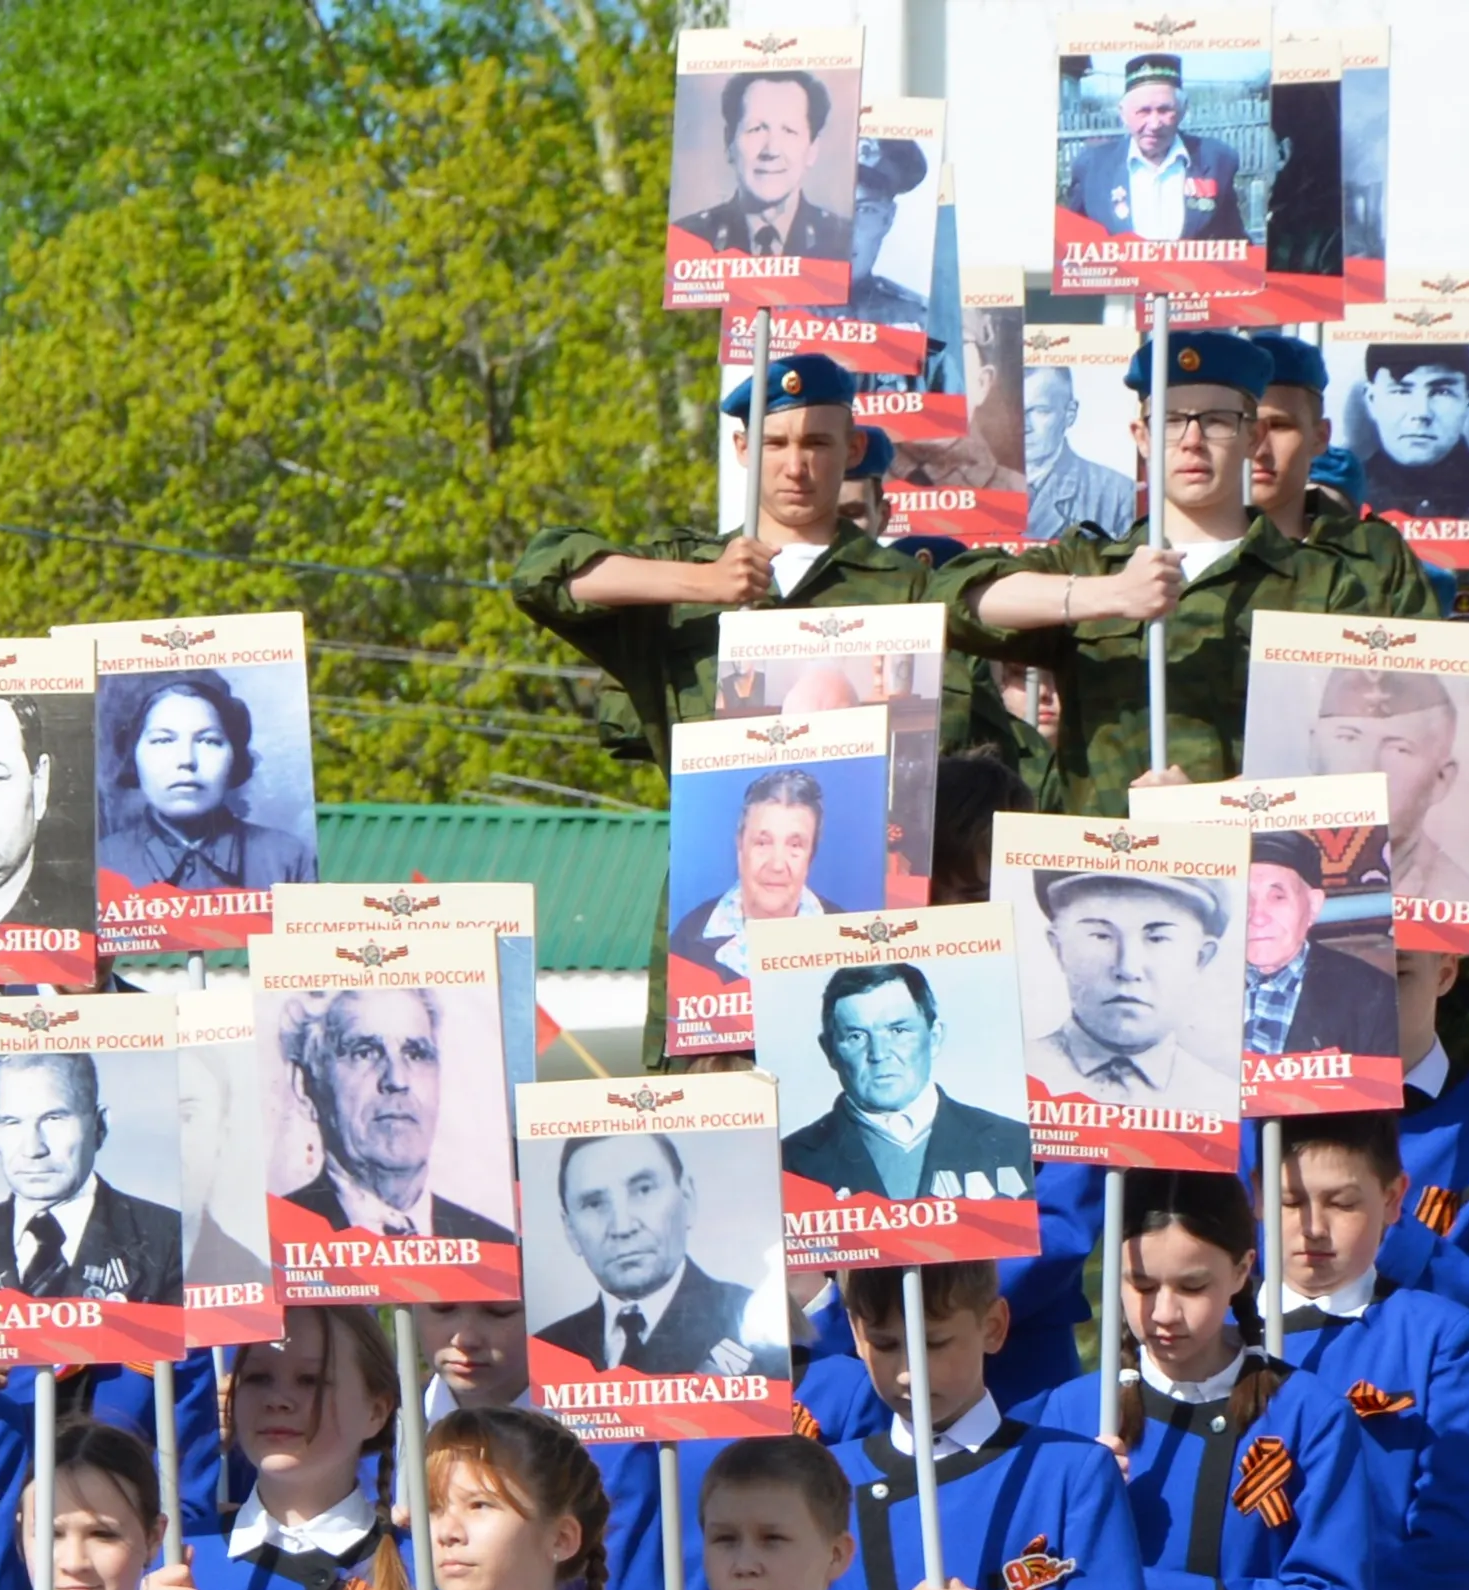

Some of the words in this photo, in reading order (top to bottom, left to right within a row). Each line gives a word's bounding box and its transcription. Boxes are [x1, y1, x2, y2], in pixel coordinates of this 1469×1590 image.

[1069, 38, 1165, 52] БЕССМЕРТНЫЙ
[1168, 38, 1205, 50] ПОЛК
[1209, 37, 1262, 49] РОССИИ
[1279, 68, 1331, 80] РОССИИ
[882, 126, 933, 138] РОССИИ
[1062, 239, 1249, 265] ДАВЛЕТШИН
[674, 256, 802, 280] ОЖГИХИН
[965, 294, 1015, 305] РОССИИ
[1044, 353, 1077, 364] ПОЛК
[1081, 353, 1129, 365] РОССИИ
[730, 640, 829, 657] БЕССМЕРТНЫЙ
[834, 640, 872, 653] ПОЛК
[876, 638, 931, 651] РОССИИ
[185, 652, 226, 666] ПОЛК
[232, 649, 293, 663] РОССИИ
[1265, 648, 1377, 667] БЕССМЕРТНЫЙ
[1382, 655, 1425, 669] ПОЛК
[31, 677, 84, 690] РОССИИ
[681, 747, 777, 771] БЕССМЕРТНЫЙ
[782, 747, 817, 761] ПОЛК
[822, 742, 875, 757] РОССИИ
[1264, 812, 1308, 828] ПОЛК
[1313, 809, 1376, 825] РОССИИ
[1005, 852, 1120, 870] БЕССМЕРТНЫЙ
[1125, 858, 1169, 873] ПОЛК
[1173, 861, 1237, 876] РОССИИ
[761, 947, 880, 971] БЕССМЕРТНЫЙ
[886, 945, 931, 960] ПОЛК
[937, 939, 1001, 957] РОССИИ
[264, 969, 373, 988] БЕССМЕРТНЫЙ
[379, 971, 420, 985] ПОЛК
[426, 970, 485, 983] РОССИИ
[45, 1035, 91, 1050] ПОЛК
[97, 1034, 164, 1049] РОССИИ
[530, 1114, 646, 1135] БЕССМЕРТНЫЙ
[652, 1115, 696, 1130] ПОЛК
[701, 1112, 764, 1127] РОССИИ
[784, 1201, 958, 1236] МИНАЗОВ
[786, 1236, 839, 1250] КАСИМ
[283, 1238, 481, 1268] ПАТРАКЕЕВ
[786, 1248, 879, 1266] МИНАЗОВИЧ
[286, 1270, 323, 1282] ИВАН
[286, 1284, 380, 1298] СТЕПАНОВИЧ
[542, 1375, 769, 1409] МИНЛИКАЕВ
